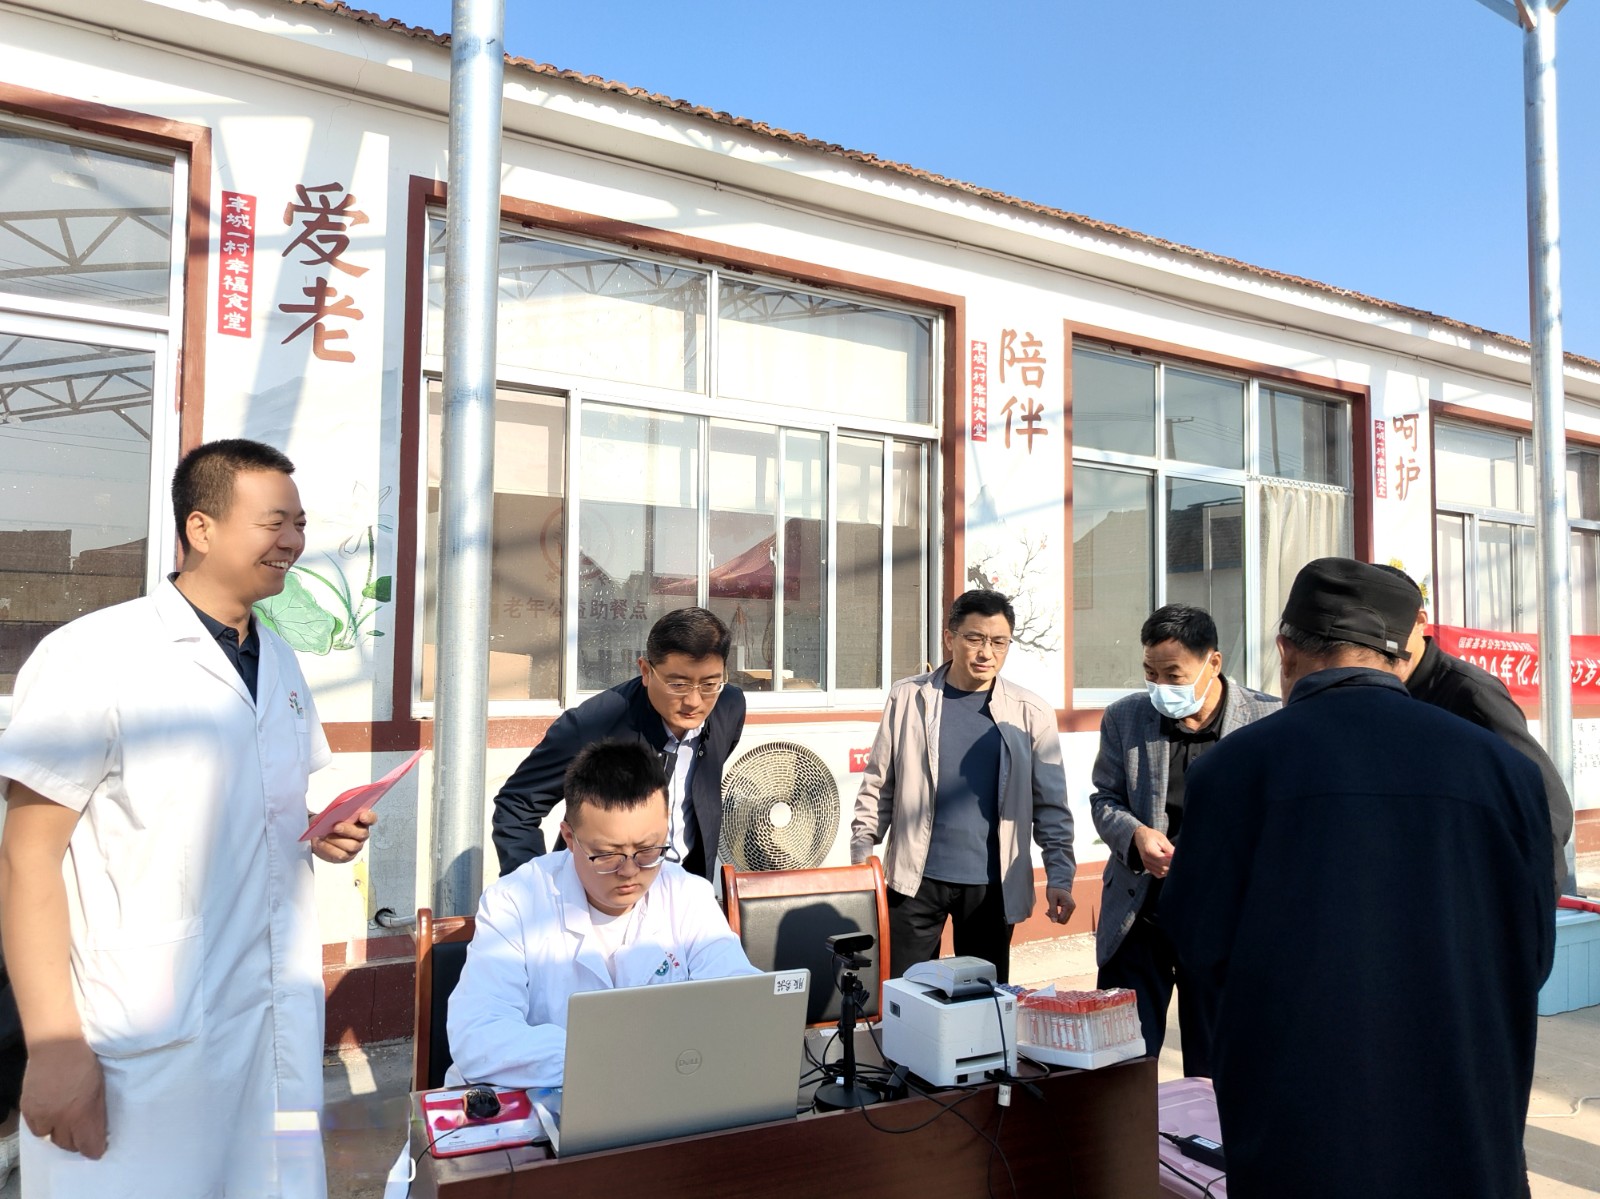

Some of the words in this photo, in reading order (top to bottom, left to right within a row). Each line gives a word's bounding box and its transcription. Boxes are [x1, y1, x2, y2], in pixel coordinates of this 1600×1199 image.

[278, 183, 370, 363] 爱老
[999, 328, 1049, 455] 陪伴
[1393, 413, 1421, 501] 呵护
